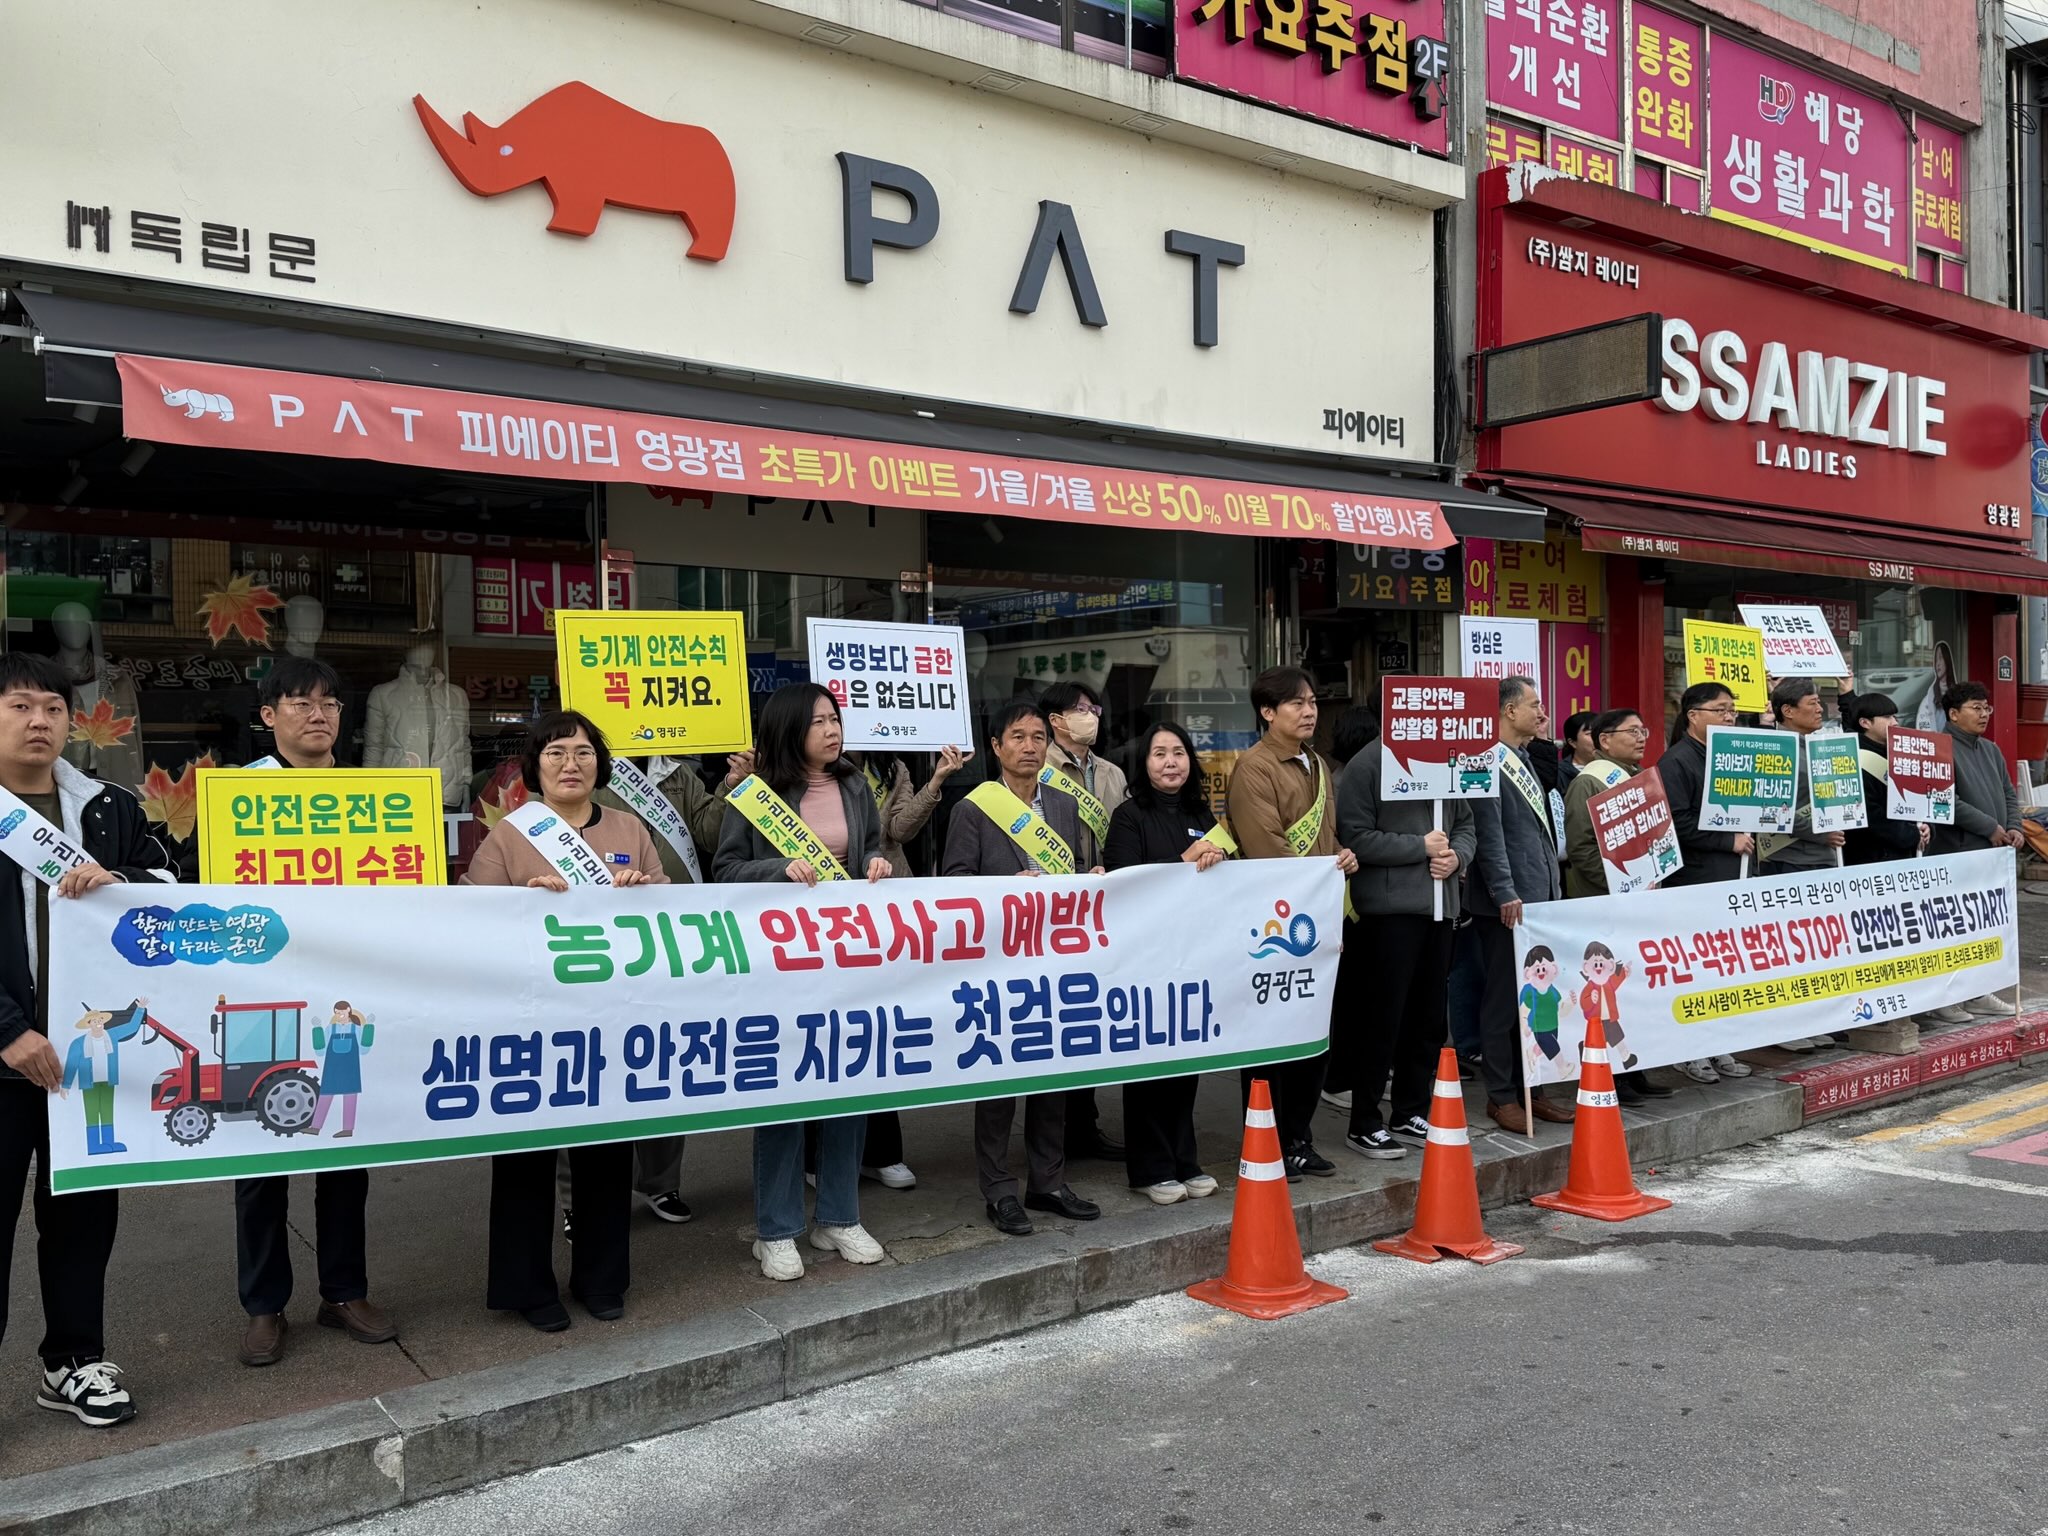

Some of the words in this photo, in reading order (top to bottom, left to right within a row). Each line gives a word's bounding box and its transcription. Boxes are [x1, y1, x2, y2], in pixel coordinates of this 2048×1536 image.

[1414, 38, 1449, 77] 2F
[1636, 24, 1693, 88] 통증
[1636, 86, 1694, 149] 완화
[1804, 91, 1864, 156] 혜당
[1723, 134, 1895, 247] 생활과학
[1914, 188, 1962, 243] 무료체험
[131, 209, 317, 283] 독립문
[1528, 237, 1589, 277] (주)쌈지
[1595, 255, 1641, 289] 레이디
[1656, 317, 1948, 457] SSAMZIE
[1323, 408, 1405, 449] 피에이티
[460, 410, 620, 468] 피에이티
[634, 427, 747, 481] 영광점
[760, 442, 857, 490] 초특가
[868, 453, 962, 499] 이벤트
[968, 465, 1097, 514] 가을/겨울
[1102, 478, 1152, 516] 신상
[1161, 483, 1222, 525] 50%
[1225, 490, 1272, 527] 이월
[1271, 493, 1332, 532] 70%
[1333, 501, 1435, 541] 할인행사중
[1755, 440, 1858, 480] LADIES
[1986, 503, 2021, 529] 영광점
[1654, 537, 1680, 554] 레이디
[1868, 561, 1915, 582] SSAMZIE
[1495, 581, 1588, 618] 료체험
[1761, 615, 1785, 634] 멋진
[1785, 616, 1815, 634] 농부는
[579, 634, 642, 668] 농기계
[647, 634, 727, 667] 안전수칙
[825, 641, 909, 674] 생명보다
[913, 645, 953, 676] 급한
[1471, 631, 1503, 656] 방심은
[1693, 634, 1720, 657] 농기계
[1721, 637, 1757, 661] 안전수칙
[1762, 637, 1803, 657] 안전부터
[1802, 638, 1834, 657] 챙긴다
[1704, 657, 1716, 681] 꼭
[1719, 661, 1755, 685] 지켜요.
[2000, 667, 2011, 678] 192
[604, 671, 631, 709] 꼭
[641, 674, 722, 709] 지켜요.
[826, 678, 869, 709] 일은
[874, 679, 957, 711] 없습니다
[1391, 687, 1466, 712] 교통안전을
[1390, 716, 1438, 742] 생활화
[1441, 716, 1494, 742] 합시다!
[1892, 735, 1936, 757] 교통안전을
[1714, 752, 1753, 773] 찾아보자
[1754, 753, 1793, 775] 위험요소
[1831, 756, 1858, 776] 위험요소
[1893, 756, 1921, 779] 생활화
[1921, 761, 1951, 782] 합시다!
[1595, 786, 1647, 825] 교통안전을
[1713, 777, 1752, 798] 막아내자
[1753, 778, 1792, 799] 재난사고
[231, 793, 415, 836] 안전운전은
[1603, 818, 1637, 852] 생활화
[1635, 800, 1669, 835] 합시다!
[233, 844, 345, 885] 최고의
[355, 843, 426, 885] 수확
[1728, 895, 1757, 913] 우리
[1760, 888, 1802, 910] 모두의
[1805, 882, 1847, 903] 관심이
[1848, 873, 1896, 899] 아이들의
[1897, 866, 1953, 893] 안전입니다.
[132, 911, 177, 935] 함께
[178, 914, 222, 934] 만드는
[224, 910, 271, 936] 영광
[545, 911, 751, 984] 농기계
[758, 896, 987, 973] 안전사고
[1001, 888, 1110, 958] 예방!
[1741, 921, 1791, 972] 범죄
[1787, 912, 1851, 964] STOP!
[1850, 904, 1904, 954] 안전한
[1962, 886, 2009, 933] START!
[135, 935, 177, 959] 같이
[180, 936, 225, 956] 누리는
[226, 932, 267, 958] 군민
[1250, 967, 1316, 1006] 영광군
[1682, 998, 1706, 1019] 낯선
[1708, 989, 1742, 1014] 사람이
[1743, 988, 1765, 1008] 주는
[1765, 981, 1790, 1004] 음식,
[1790, 978, 1810, 999] 선물
[1810, 974, 1831, 996] 받지
[1830, 971, 1850, 992] 않기
[1855, 961, 1897, 987] 부모님에게
[1896, 957, 1920, 978] 목적지
[1919, 953, 1942, 975] 알리기
[1944, 951, 1953, 968] 큰
[1952, 946, 1973, 966] 소리로
[1876, 993, 1908, 1015] 영광군
[422, 1023, 607, 1121] 생명과
[622, 1012, 780, 1103] 안전을
[794, 1003, 934, 1084] 지키는
[951, 971, 1222, 1071] 첫걸음입니다.
[1931, 1053, 1968, 1075] 소방시설
[1969, 1039, 2014, 1063] 주정차금지
[1817, 1080, 1859, 1106] 소방시설
[1861, 1065, 1911, 1094] 주정차금지
